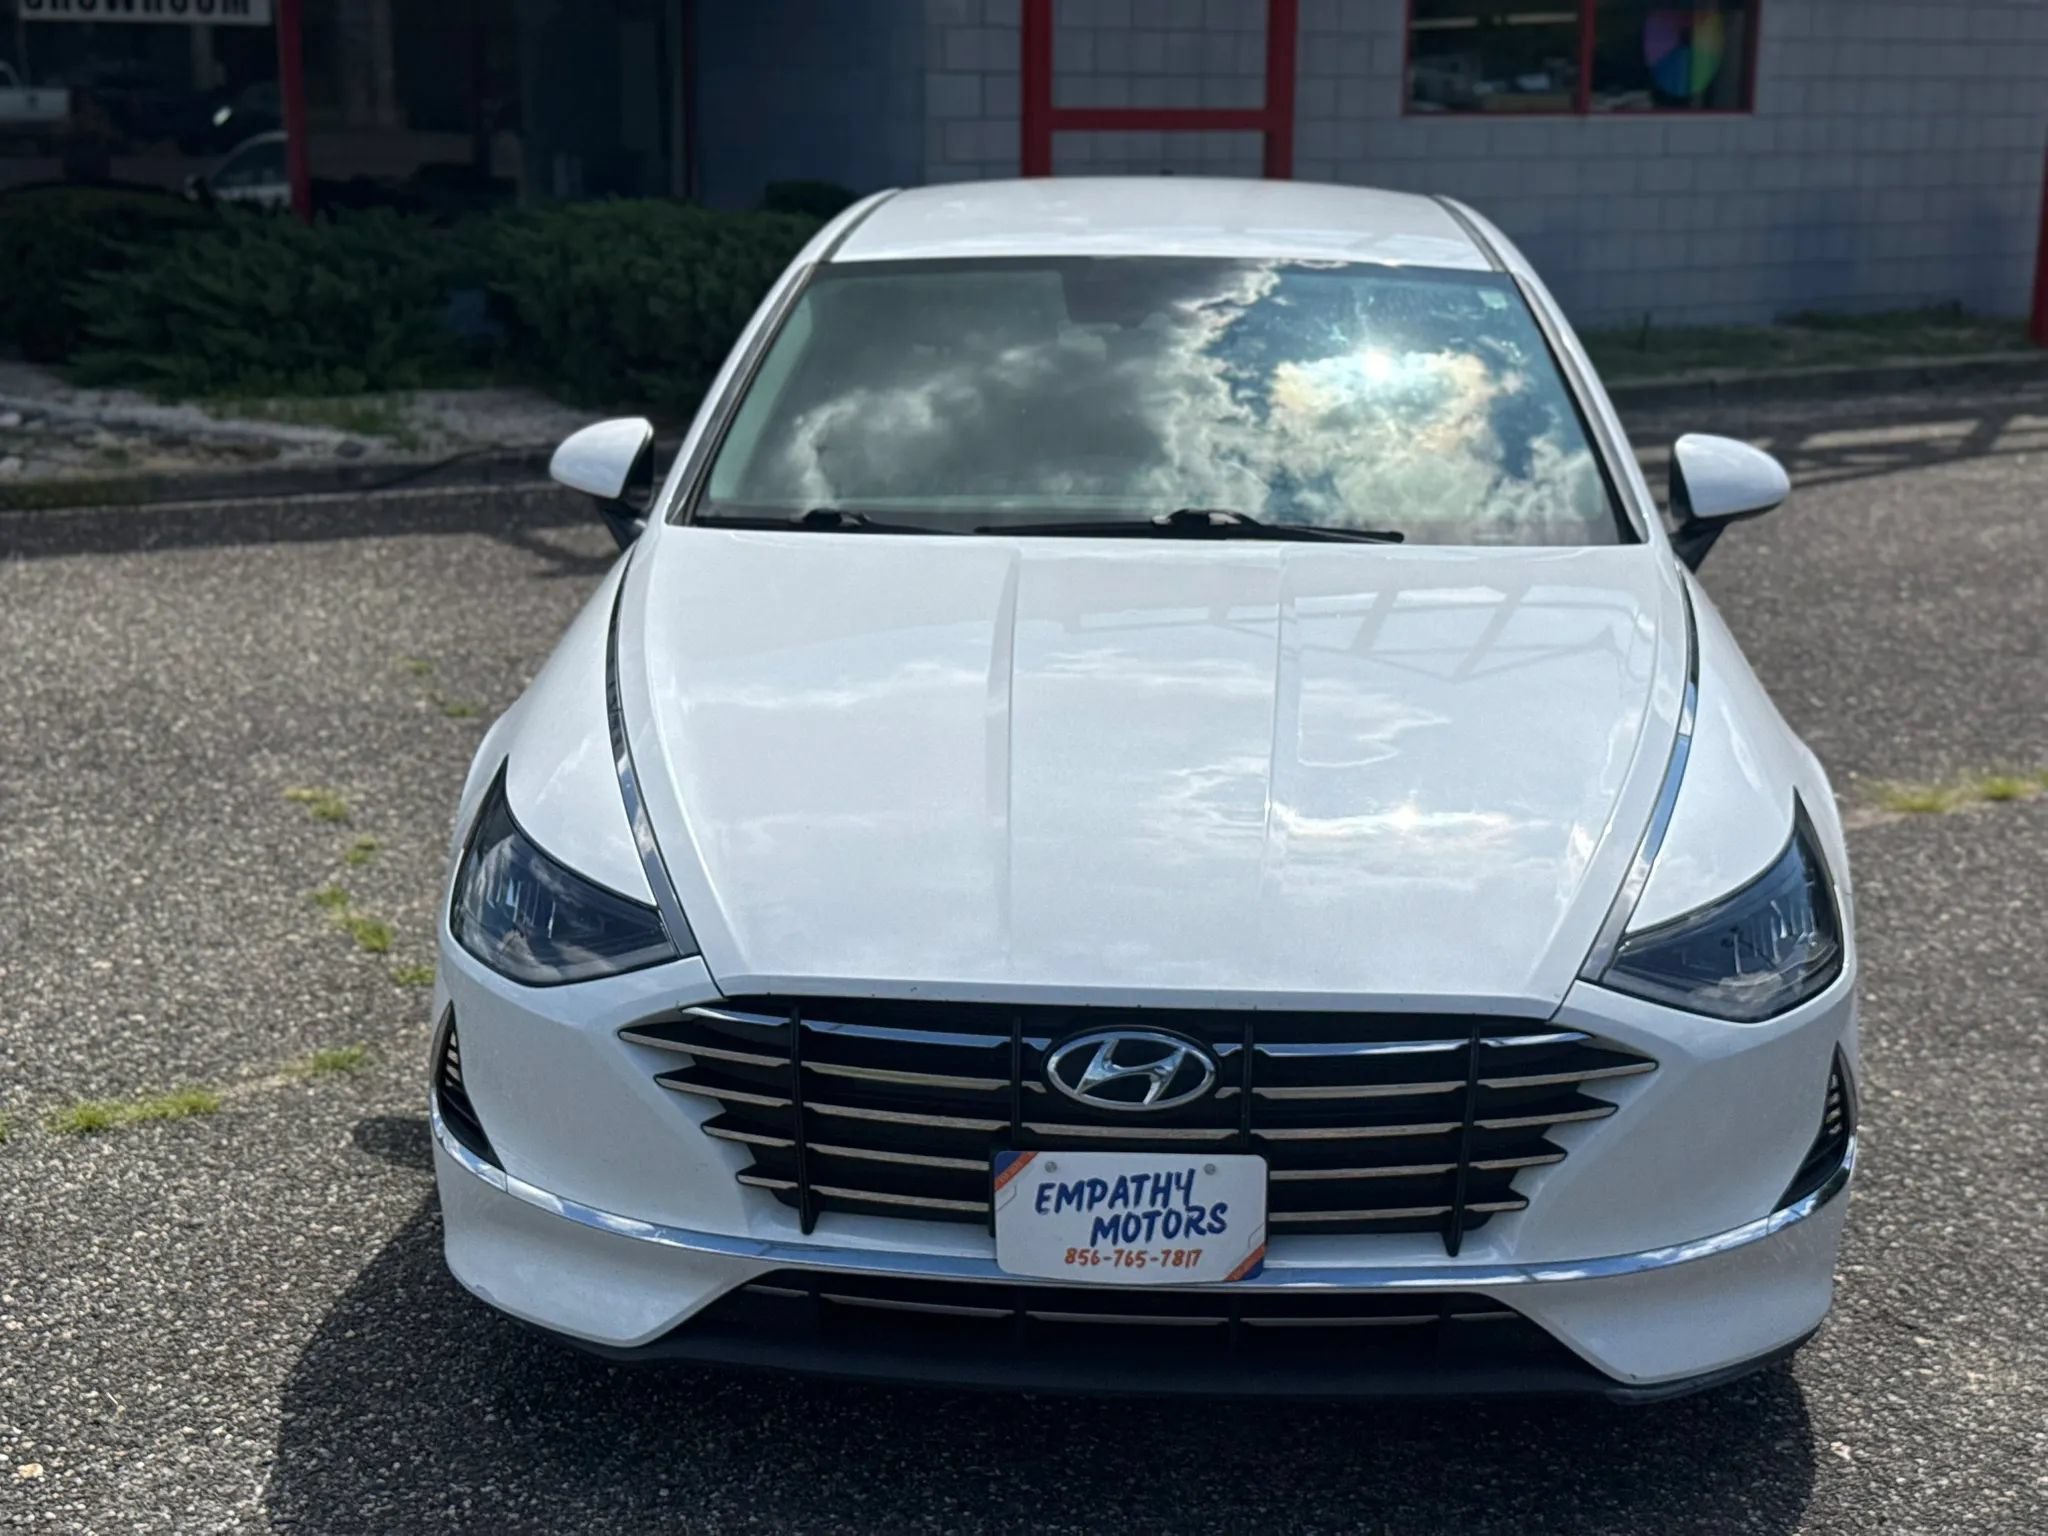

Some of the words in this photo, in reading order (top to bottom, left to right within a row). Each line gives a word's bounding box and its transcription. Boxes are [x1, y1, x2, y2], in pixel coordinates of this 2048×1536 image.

[1035, 1168, 1196, 1215] EMPATHY
[1090, 1202, 1229, 1247] MOTORS
[1064, 1248, 1203, 1268] 856-765-7817
